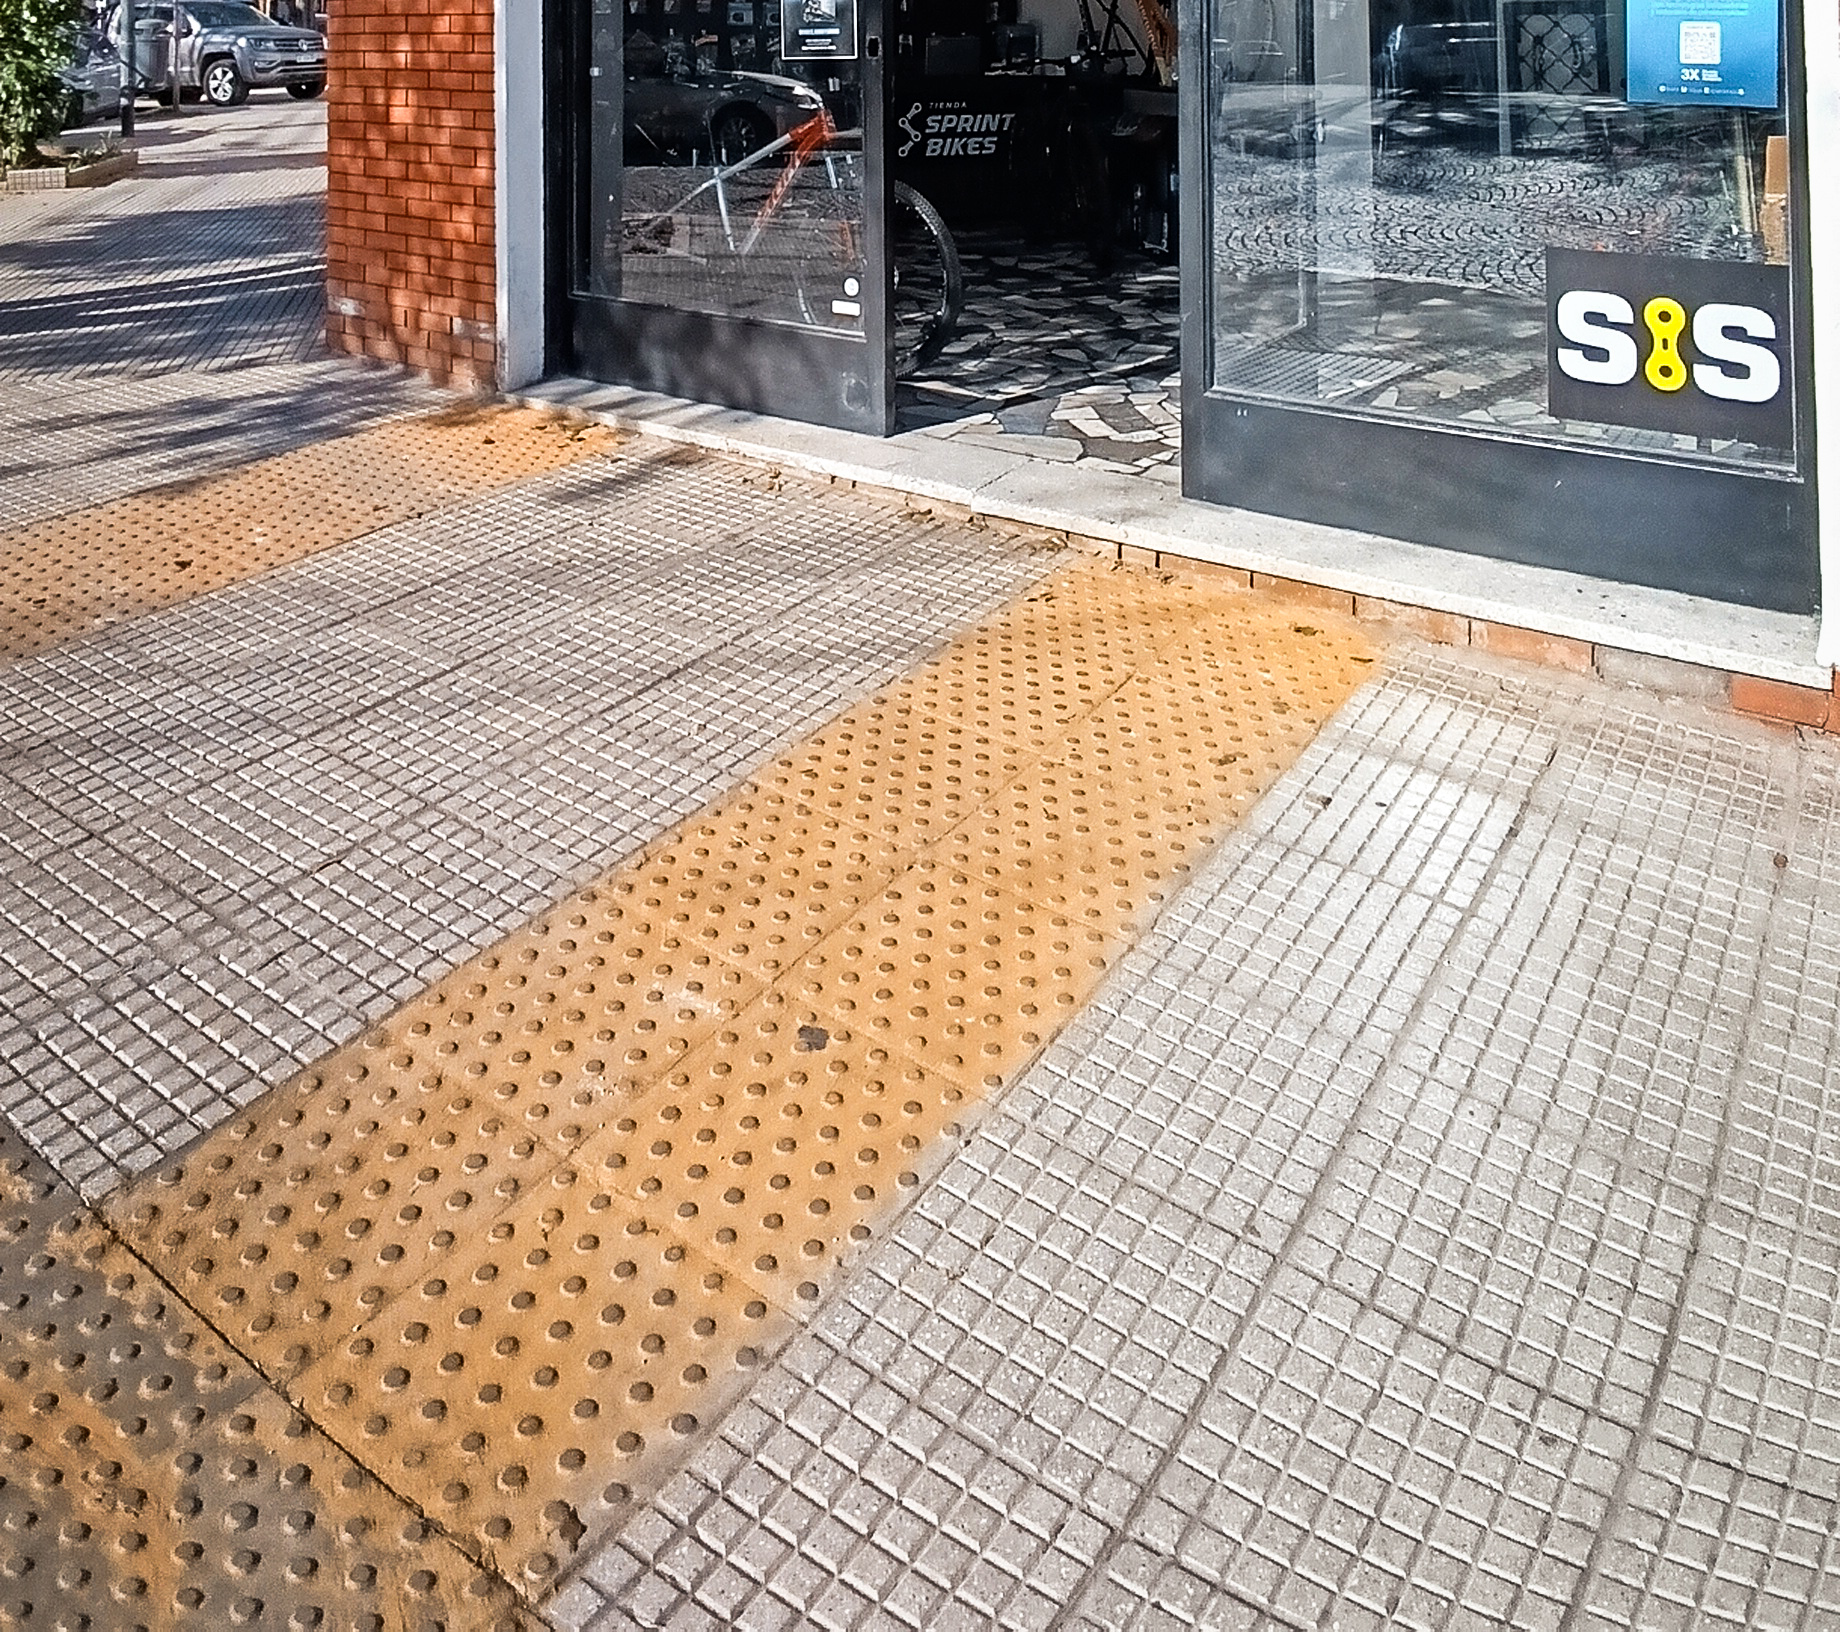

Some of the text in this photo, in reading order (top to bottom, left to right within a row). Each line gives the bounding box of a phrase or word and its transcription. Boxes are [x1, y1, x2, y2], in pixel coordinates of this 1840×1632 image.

[1680, 68, 1700, 81] 3X
[929, 101, 967, 109] TIENDA
[925, 113, 1016, 134] SPRINT
[925, 136, 998, 157] BIKES
